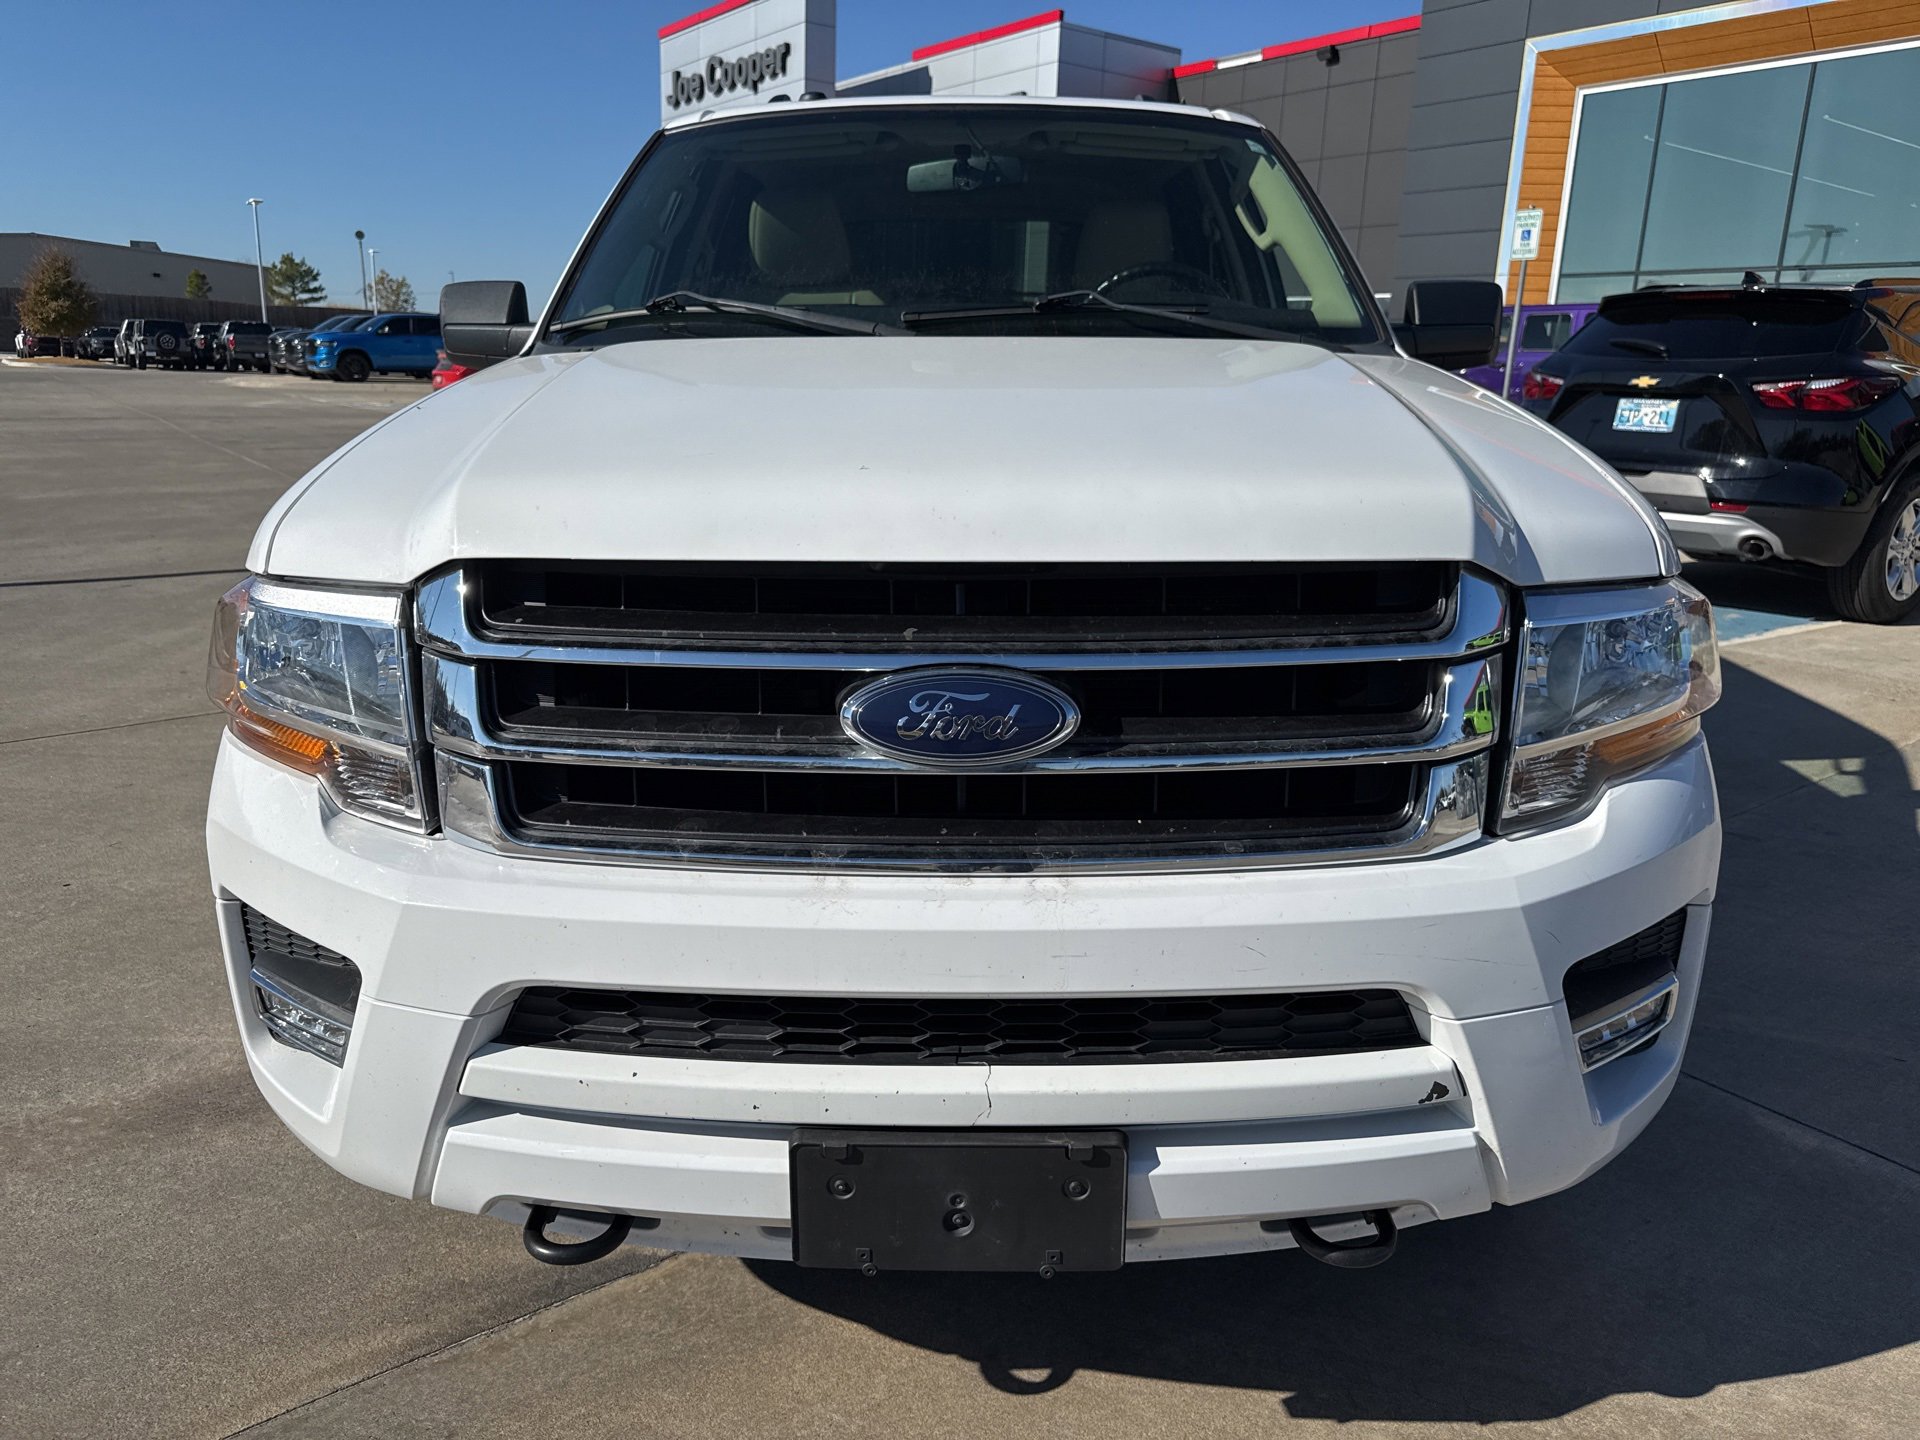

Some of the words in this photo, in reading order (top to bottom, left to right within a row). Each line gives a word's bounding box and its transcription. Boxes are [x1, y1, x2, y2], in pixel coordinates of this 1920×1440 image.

[666, 70, 705, 109] Joe
[706, 42, 791, 96] Cooper
[896, 690, 1022, 740] Ford
